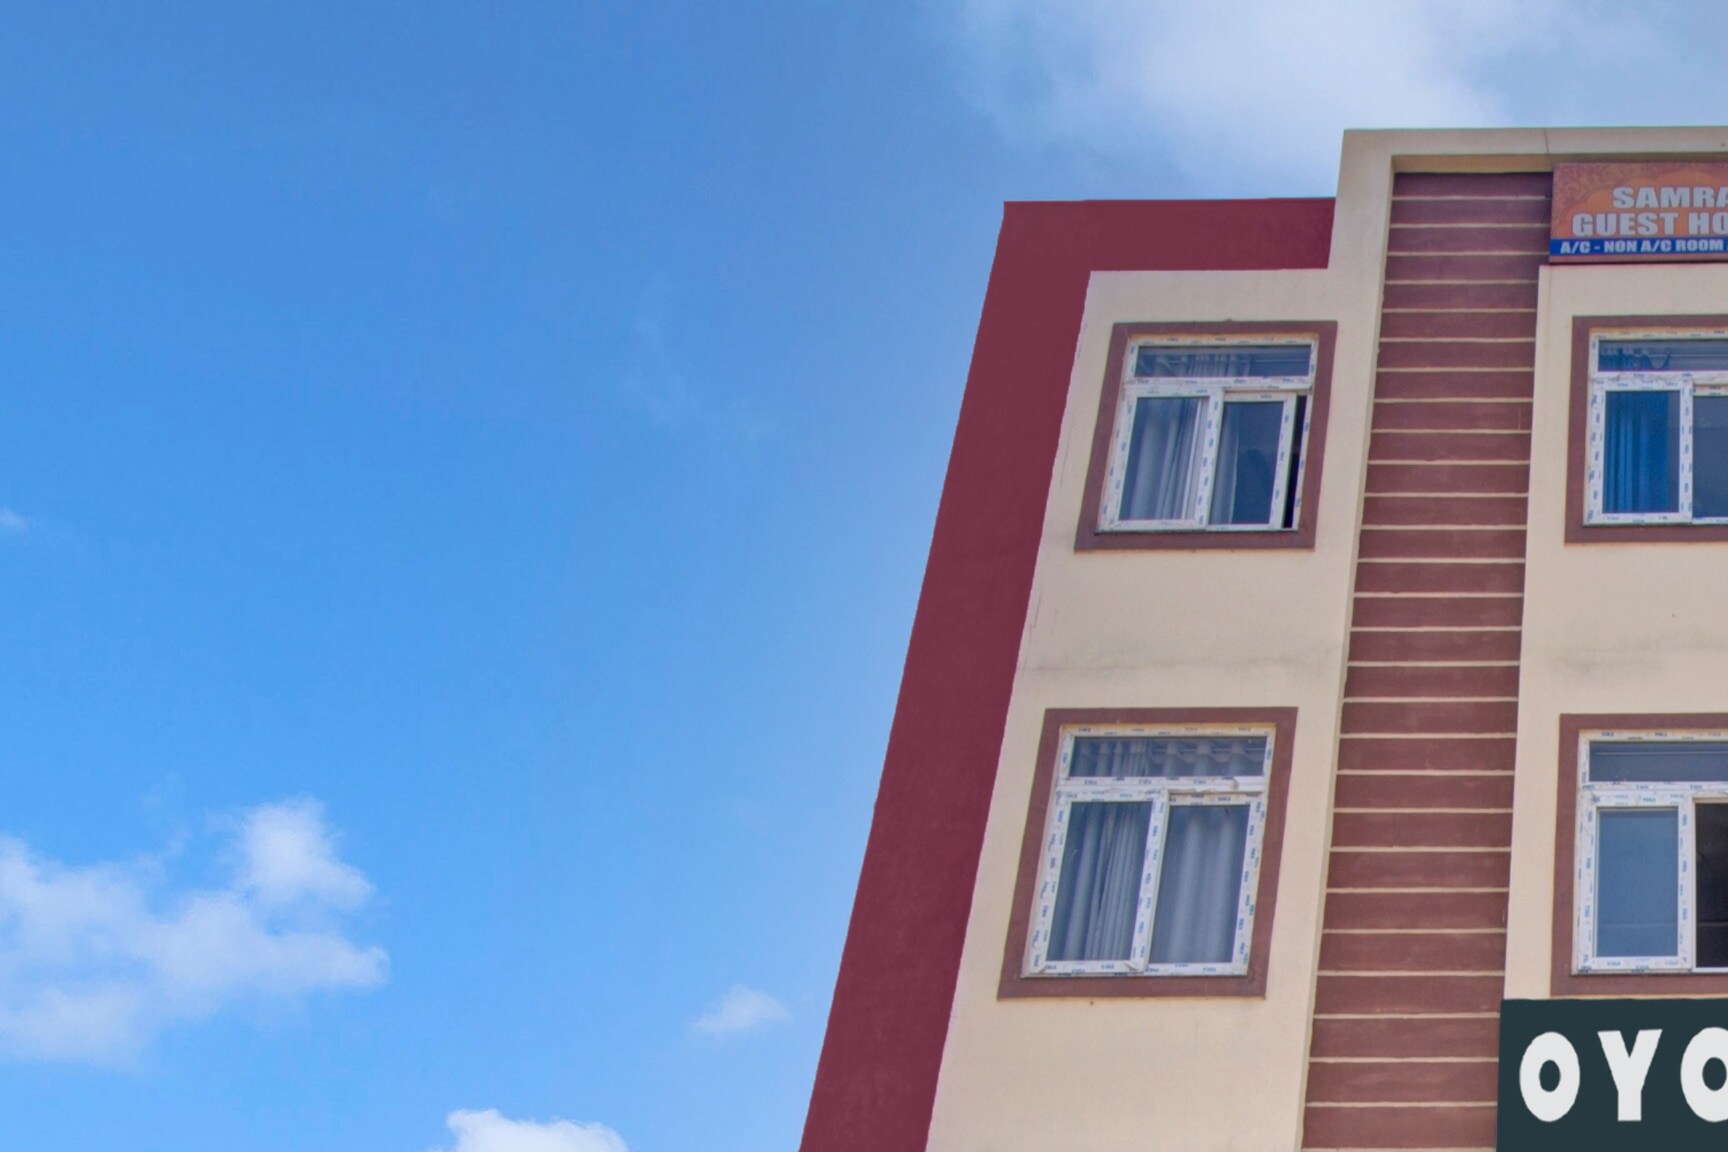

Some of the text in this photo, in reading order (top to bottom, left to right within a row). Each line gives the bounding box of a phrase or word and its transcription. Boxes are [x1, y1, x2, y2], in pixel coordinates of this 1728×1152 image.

[1572, 212, 1679, 236] GUEST
[1560, 241, 1591, 254] A/C
[1604, 240, 1637, 253] NON
[1641, 239, 1672, 252] A/C
[1675, 238, 1723, 251] ROOM
